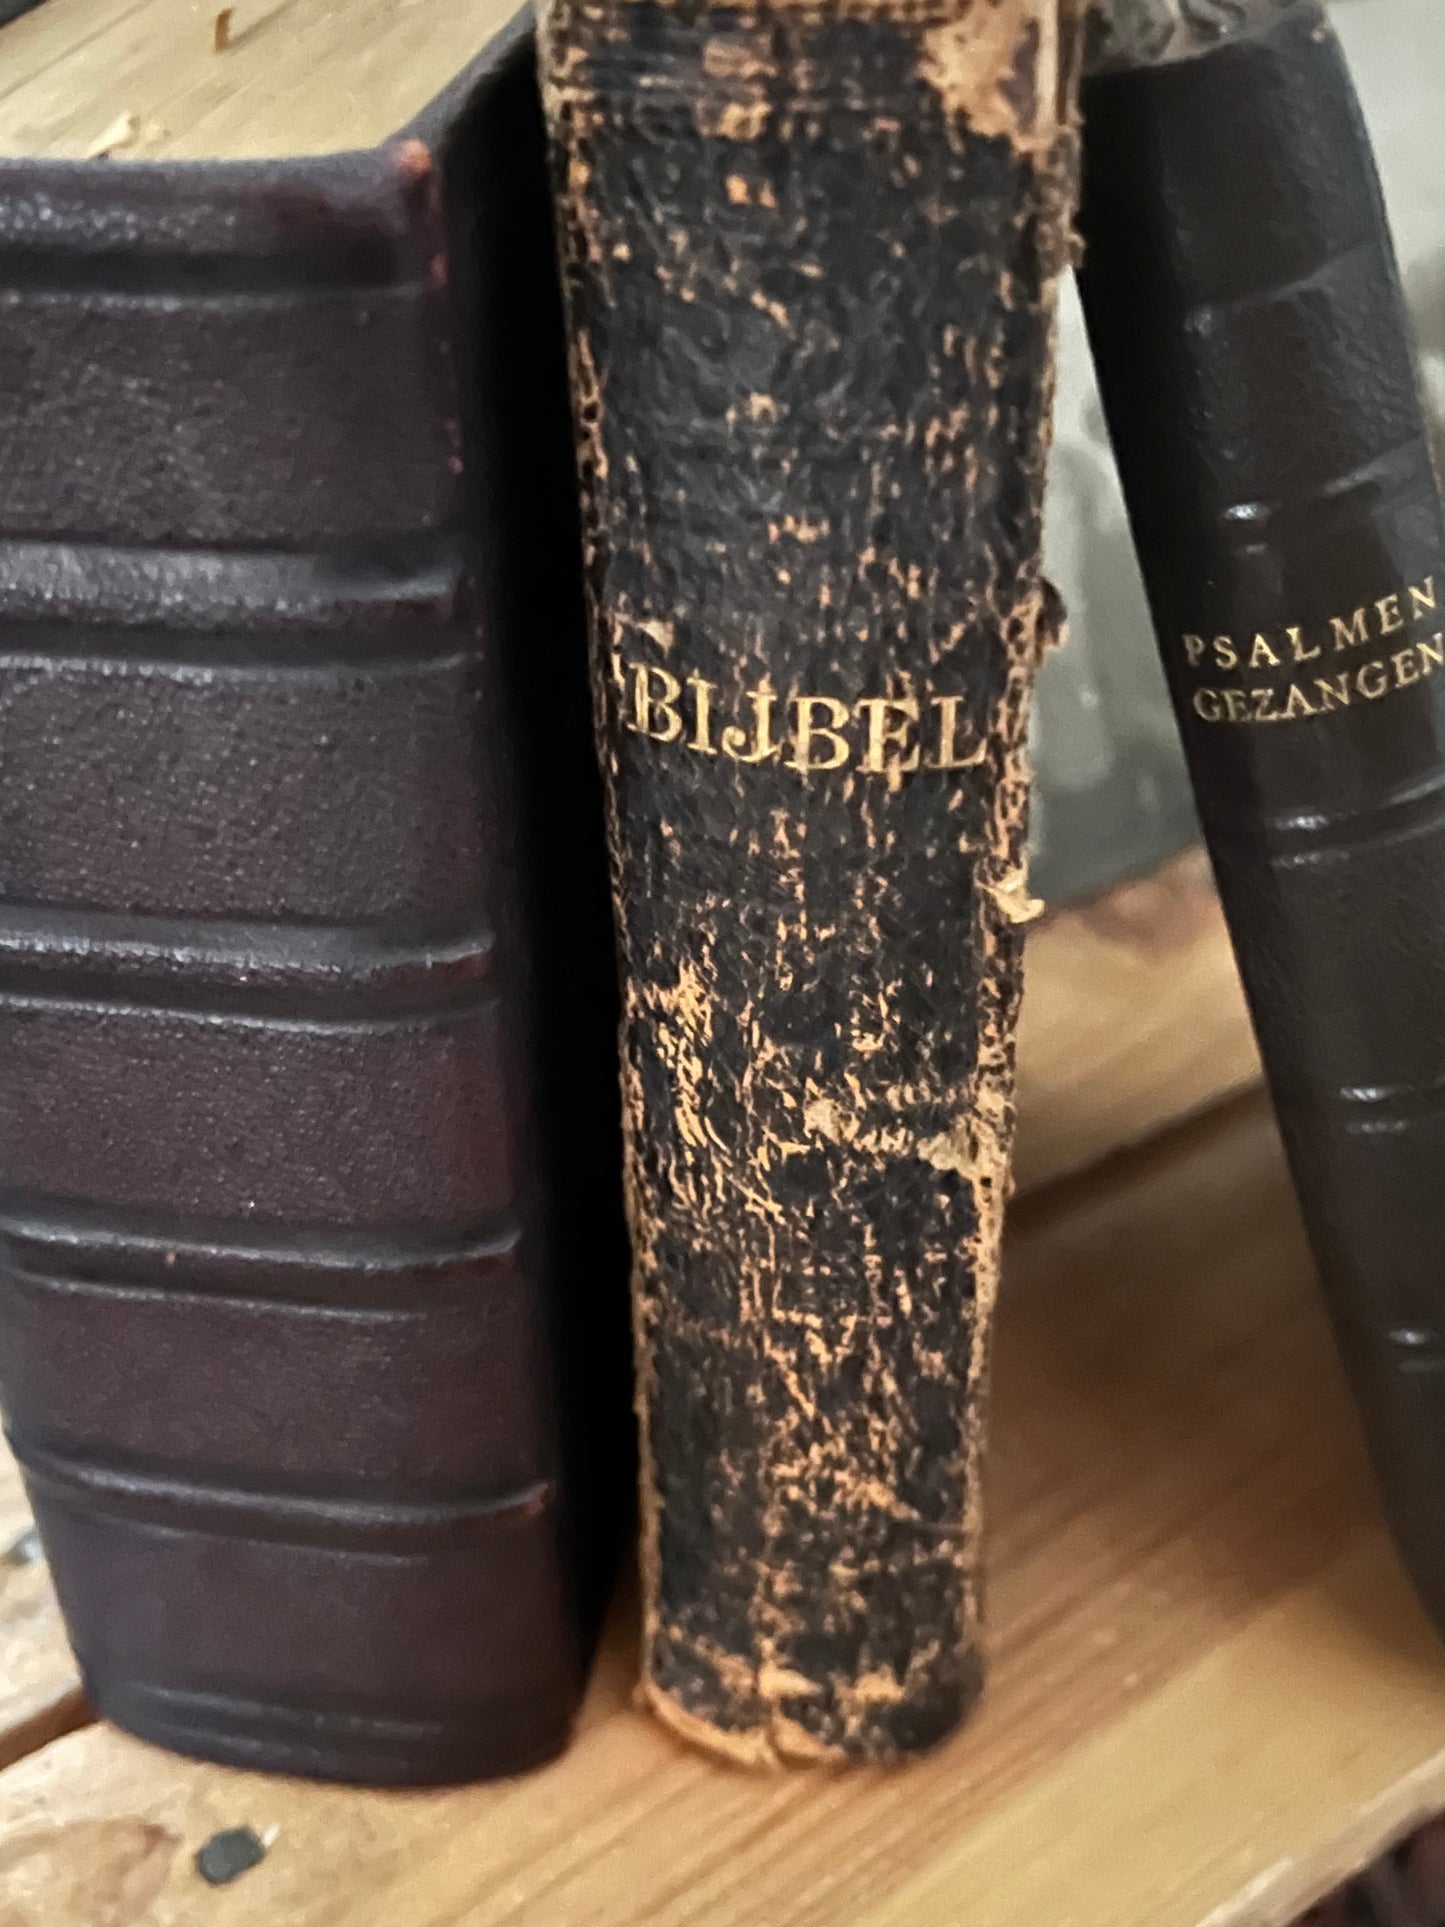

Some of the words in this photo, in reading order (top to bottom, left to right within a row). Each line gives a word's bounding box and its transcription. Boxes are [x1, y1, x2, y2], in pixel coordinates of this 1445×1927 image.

[1182, 576, 1437, 671] PSALMEN
[627, 661, 988, 774] BIJBEL
[1193, 632, 1445, 723] GEZANGEN
